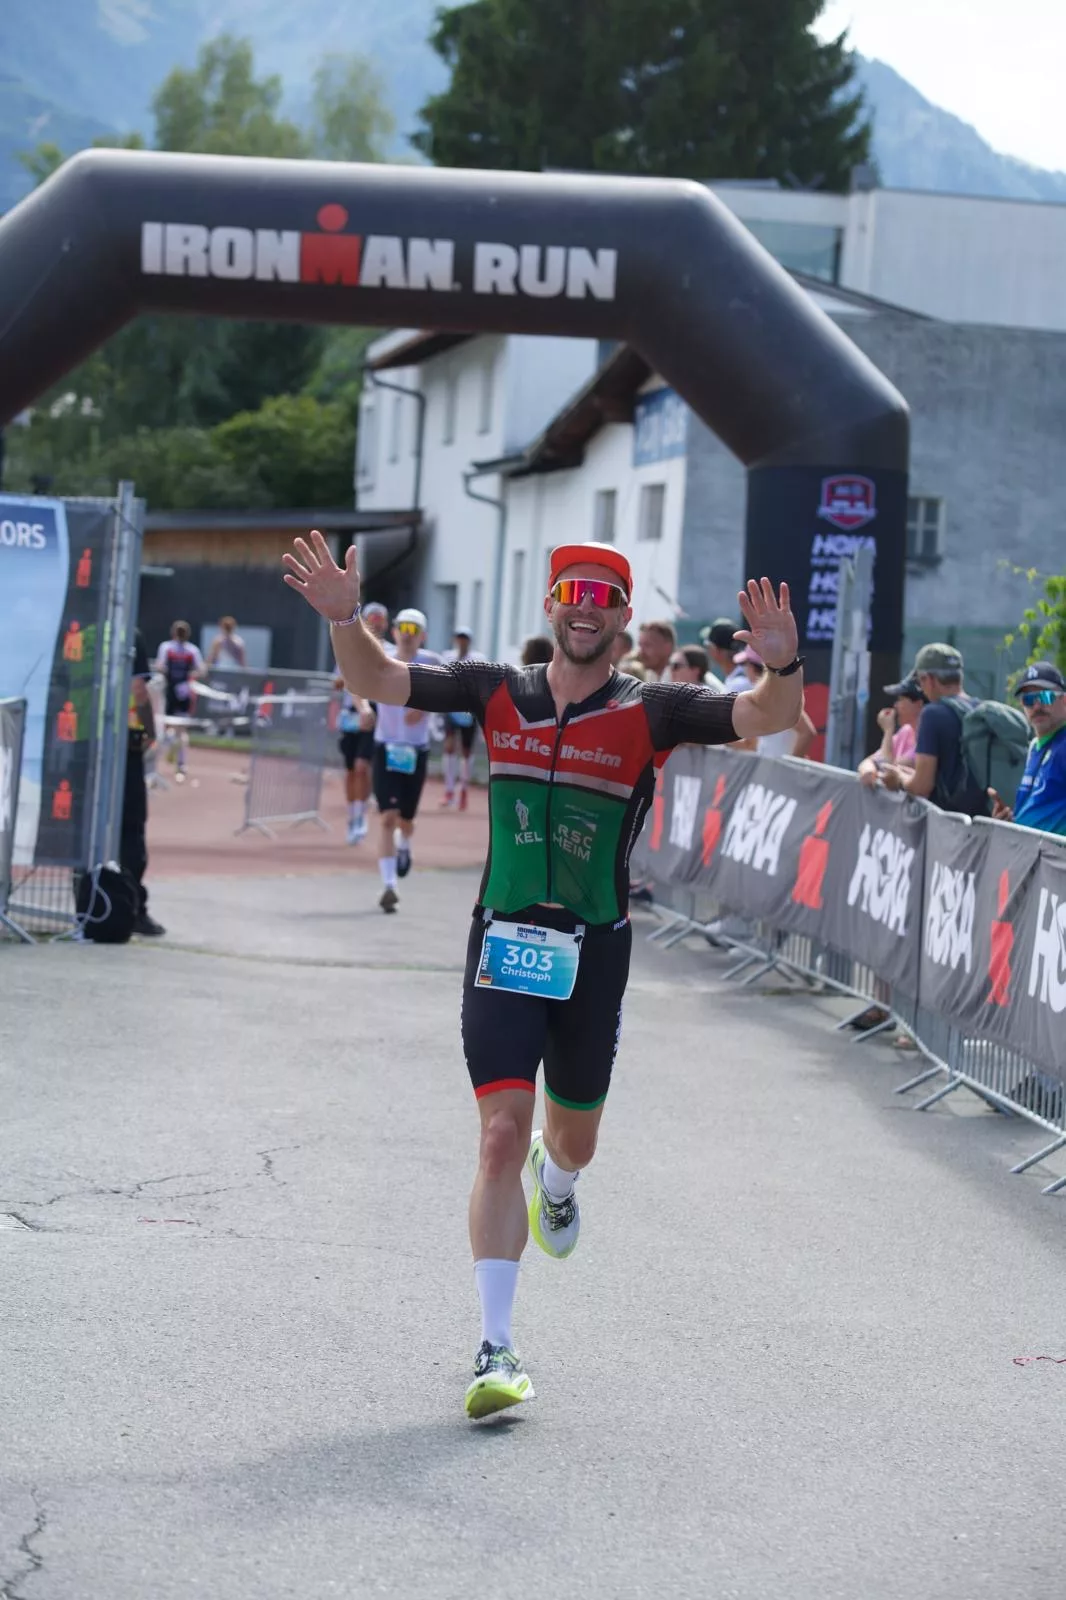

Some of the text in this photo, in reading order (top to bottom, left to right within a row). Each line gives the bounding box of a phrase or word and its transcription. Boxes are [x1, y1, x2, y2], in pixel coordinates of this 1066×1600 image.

[142, 204, 618, 301] IRONMAN RUN
[492, 730, 521, 751] RSC
[558, 823, 593, 850] RSC
[502, 944, 554, 972] 303
[501, 966, 551, 982] Christoph
